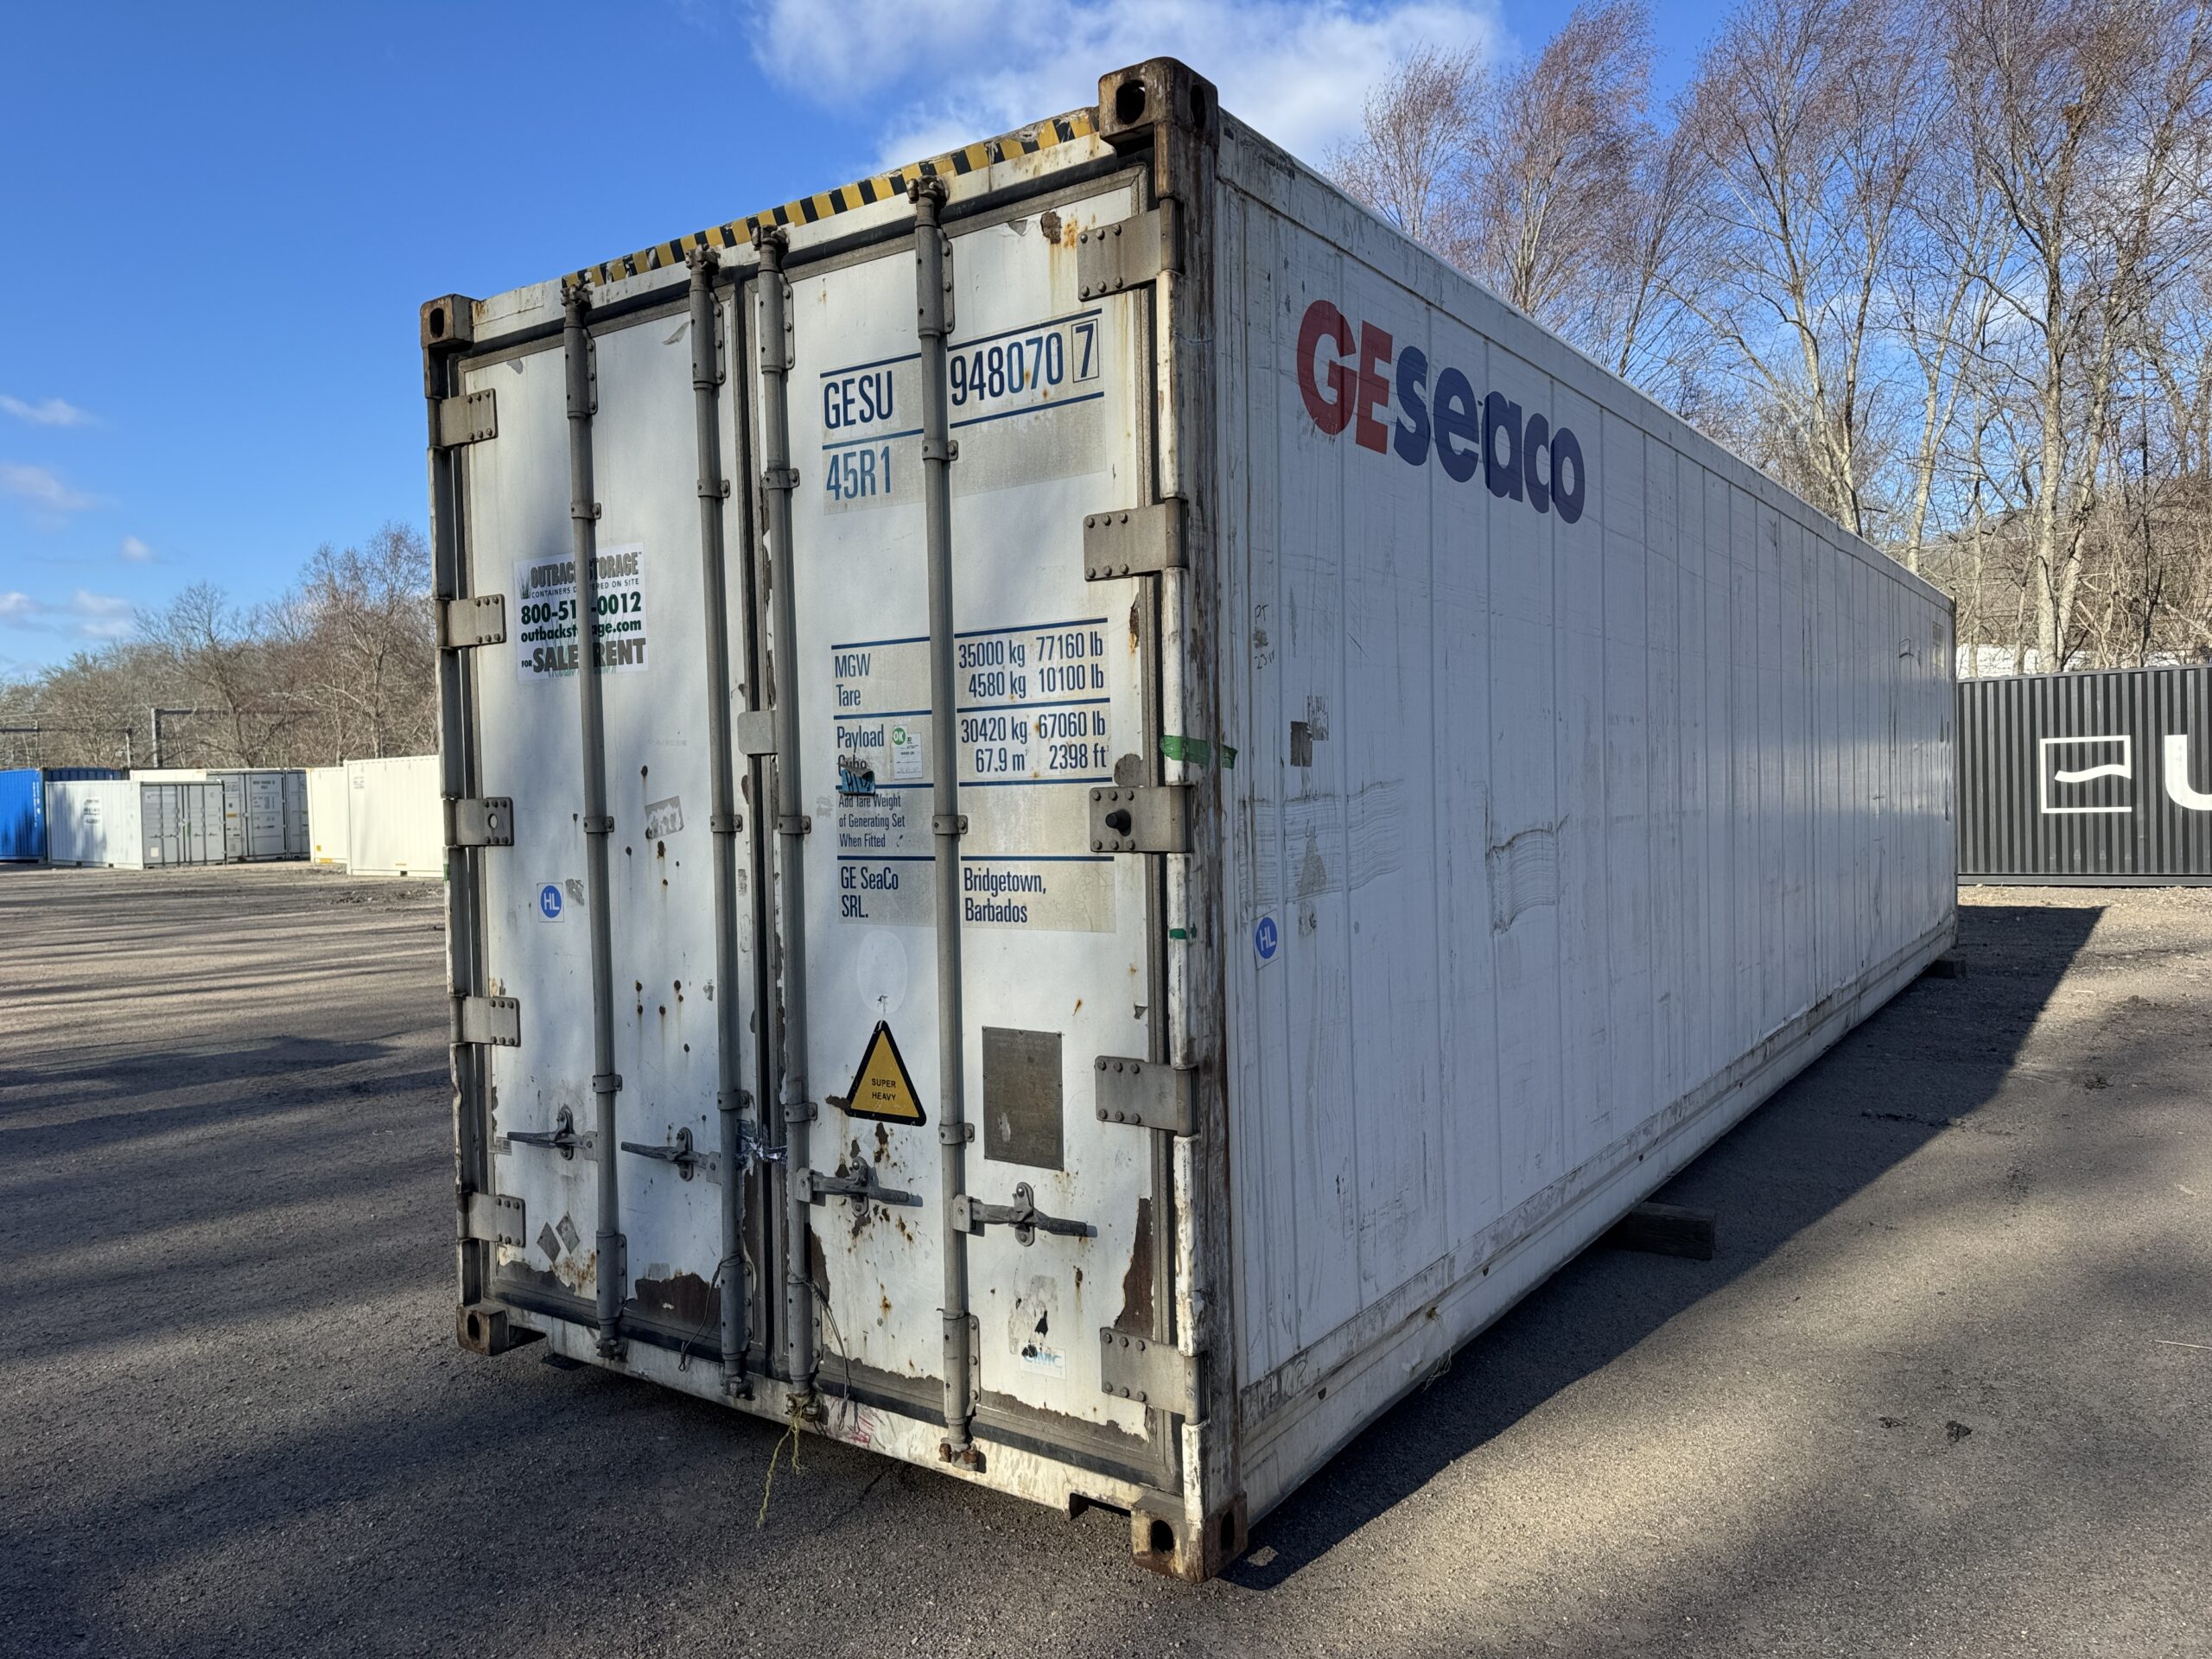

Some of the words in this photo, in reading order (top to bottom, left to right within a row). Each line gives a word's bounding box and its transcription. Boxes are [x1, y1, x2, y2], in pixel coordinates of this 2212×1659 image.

[823, 370, 893, 429] GESU
[950, 332, 1065, 406] 948070
[1076, 323, 1095, 378] 7
[826, 446, 891, 501] 45R1
[531, 561, 576, 588] OUTBAC
[531, 588, 571, 599] CONTAINERS
[612, 580, 622, 588] ON
[624, 578, 639, 587] SITE
[521, 591, 641, 625] 800-51-0012
[521, 620, 642, 642] outbackstage.com
[532, 645, 579, 673] SALE
[593, 638, 646, 668] RENT
[835, 652, 871, 678] MGW
[958, 640, 1004, 669] 35000
[1008, 639, 1026, 668] kg
[1036, 632, 1085, 662] 77160
[1090, 631, 1103, 658] lb
[836, 683, 861, 707] Tare
[968, 671, 1005, 698] 4580
[1009, 671, 1027, 698] kg
[1038, 664, 1086, 693] 10100
[1090, 664, 1104, 690] lb
[836, 724, 885, 753] Payload
[961, 716, 1007, 744] 30420
[1011, 715, 1027, 745] kg
[1038, 711, 1087, 740] 67060
[1091, 710, 1106, 736] lb
[893, 730, 905, 742] OK
[976, 747, 1007, 772] 67.9
[1049, 744, 1088, 770] 2398
[838, 794, 854, 808] Add
[855, 795, 871, 808] Tare
[873, 792, 901, 810] Weight
[839, 813, 847, 828] of
[849, 813, 890, 831] Generating
[892, 813, 906, 828] Set
[839, 833, 862, 848] When
[864, 832, 886, 848] Fitted
[841, 867, 857, 889] GE
[861, 867, 899, 890] SeaCo
[964, 868, 1047, 897] Bridgetown,
[543, 893, 560, 911] HL
[842, 894, 868, 918] SRL.
[965, 898, 1027, 923] Barbados
[1258, 925, 1276, 950] HL
[871, 1077, 897, 1089] SUPER
[872, 1091, 897, 1102] HEAVY
